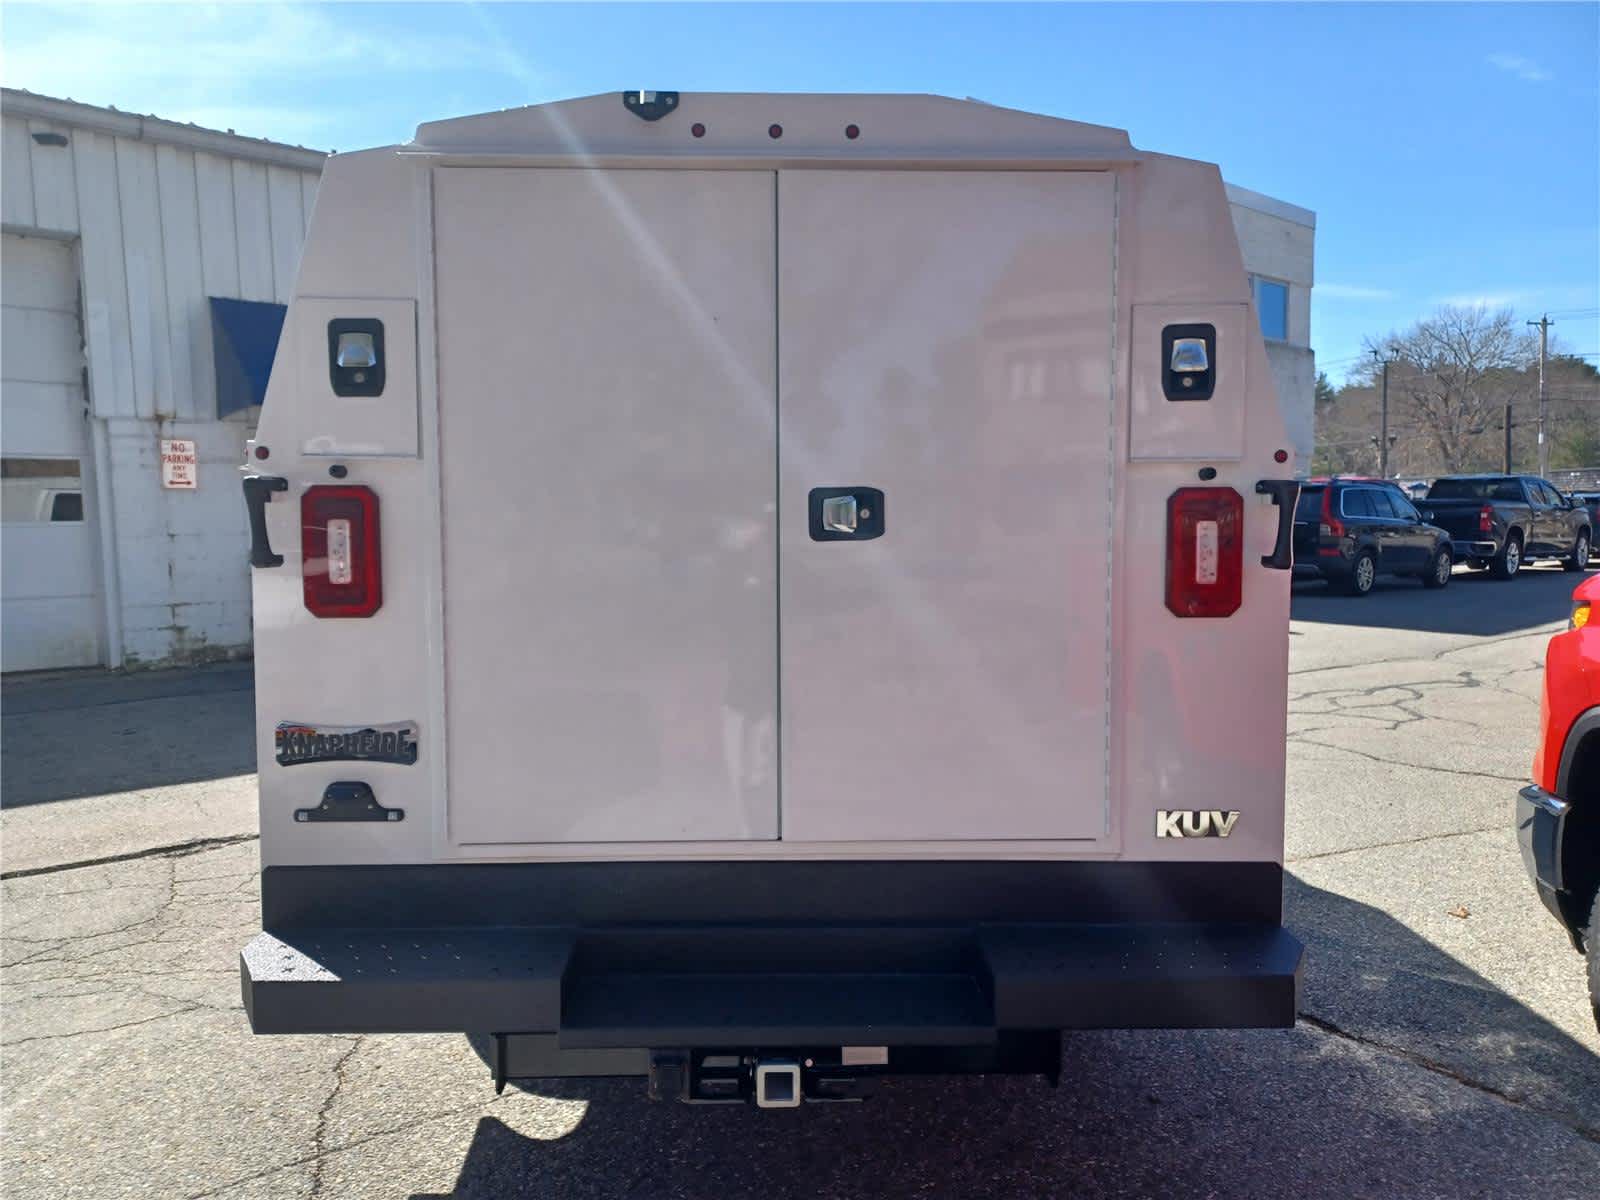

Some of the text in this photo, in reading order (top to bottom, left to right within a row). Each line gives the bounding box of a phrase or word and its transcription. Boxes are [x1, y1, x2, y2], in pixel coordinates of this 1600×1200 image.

[170, 442, 185, 453] NO
[161, 454, 195, 465] PARKING
[1156, 810, 1240, 838] KUV
